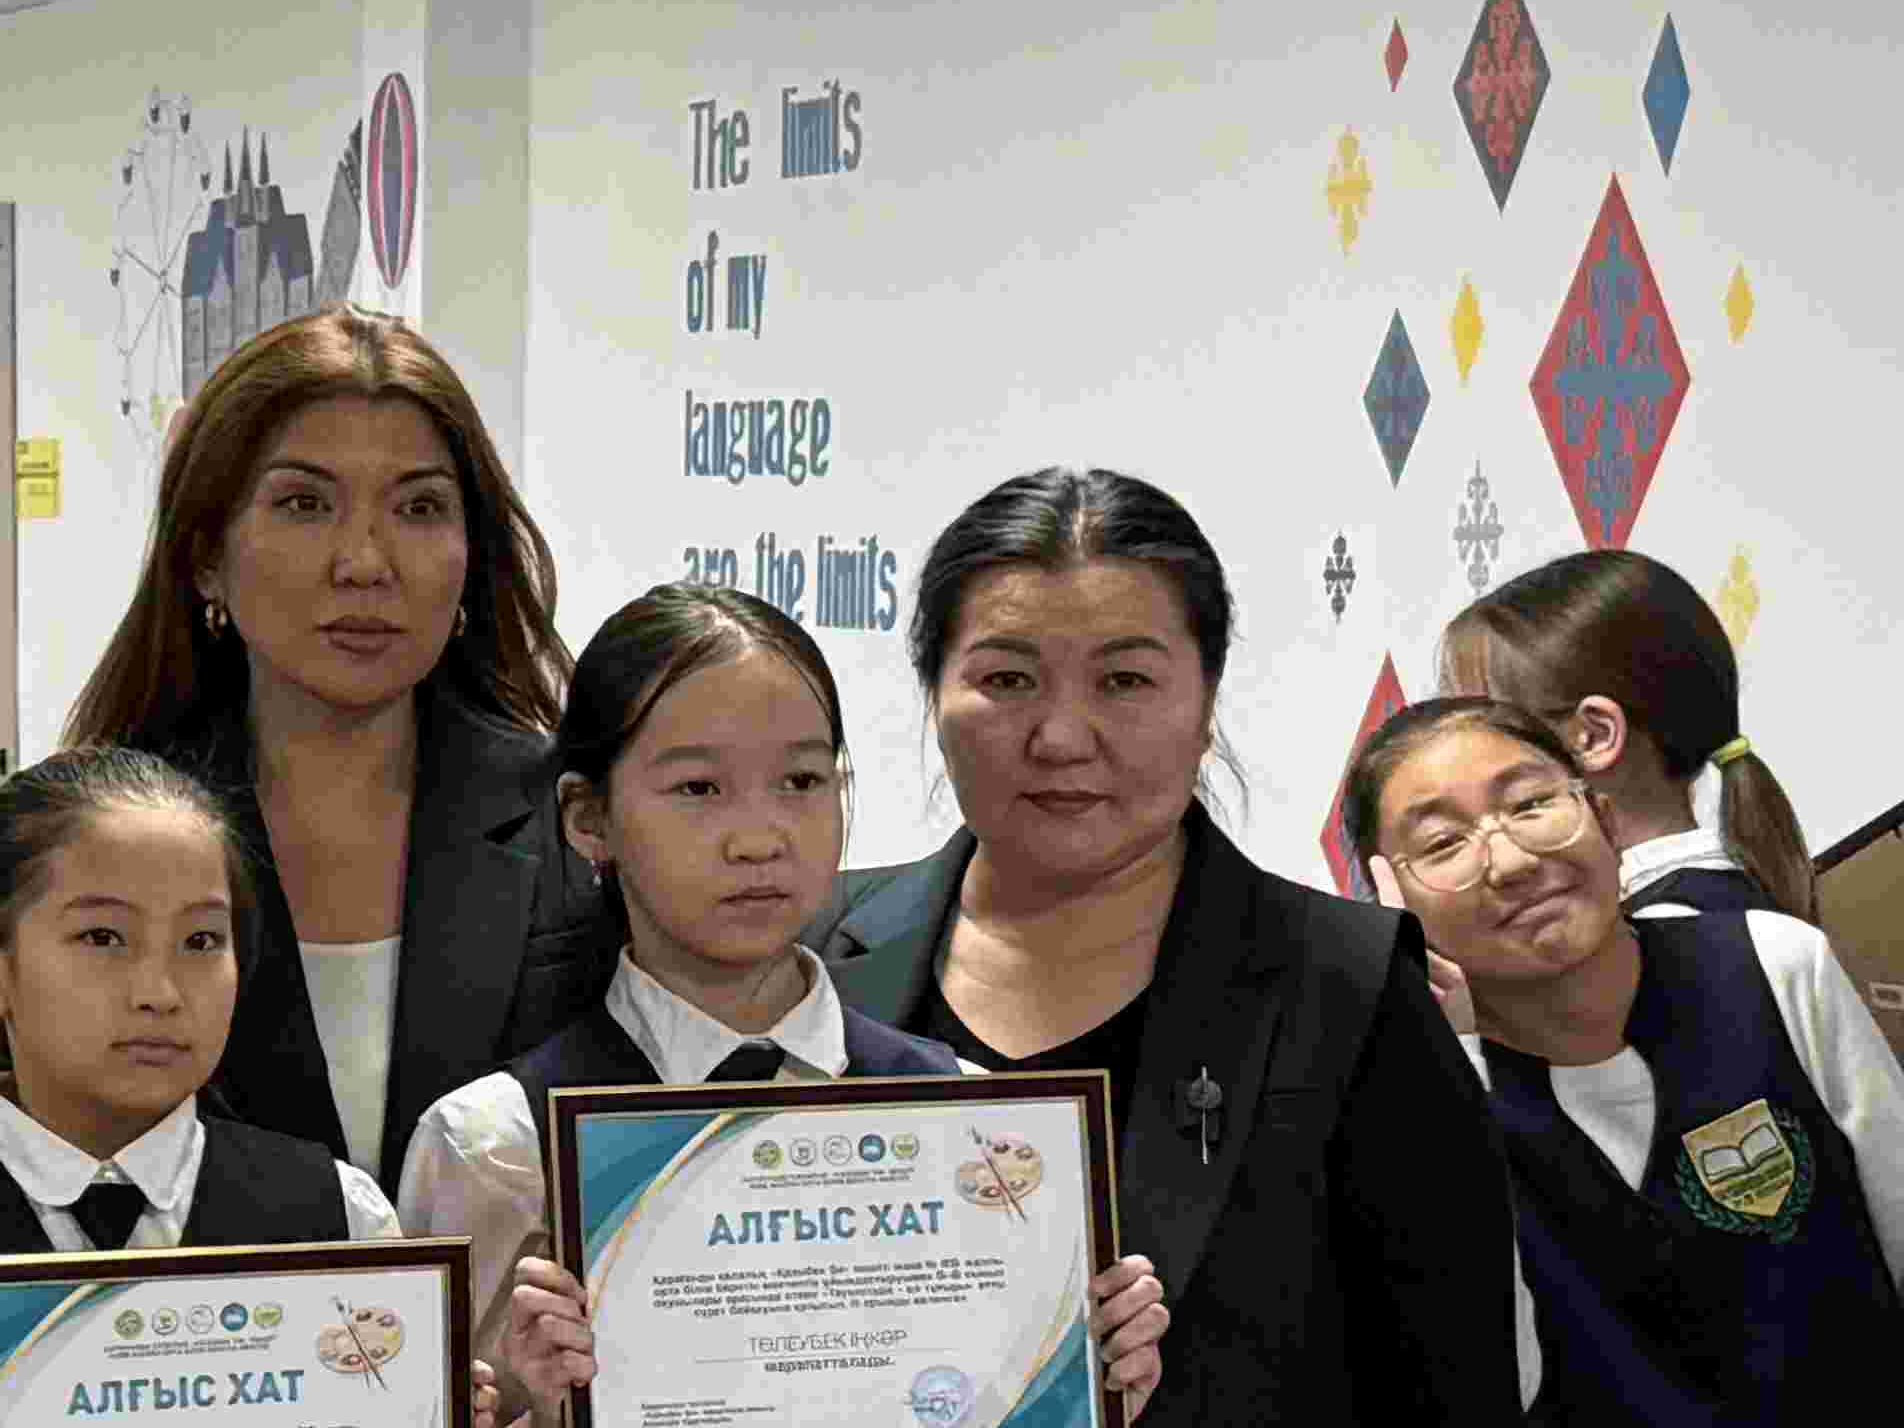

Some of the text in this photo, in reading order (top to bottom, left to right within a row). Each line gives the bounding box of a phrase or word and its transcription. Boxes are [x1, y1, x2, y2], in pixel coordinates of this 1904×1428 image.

[689, 76, 864, 190] The limits
[685, 230, 768, 340] of my
[683, 389, 831, 486] language
[754, 531, 805, 621] the
[815, 532, 897, 632] limits
[706, 1201, 945, 1245] АЛҒЫС ХАТ
[66, 1369, 304, 1414] АЛҒЫС ХАТ
